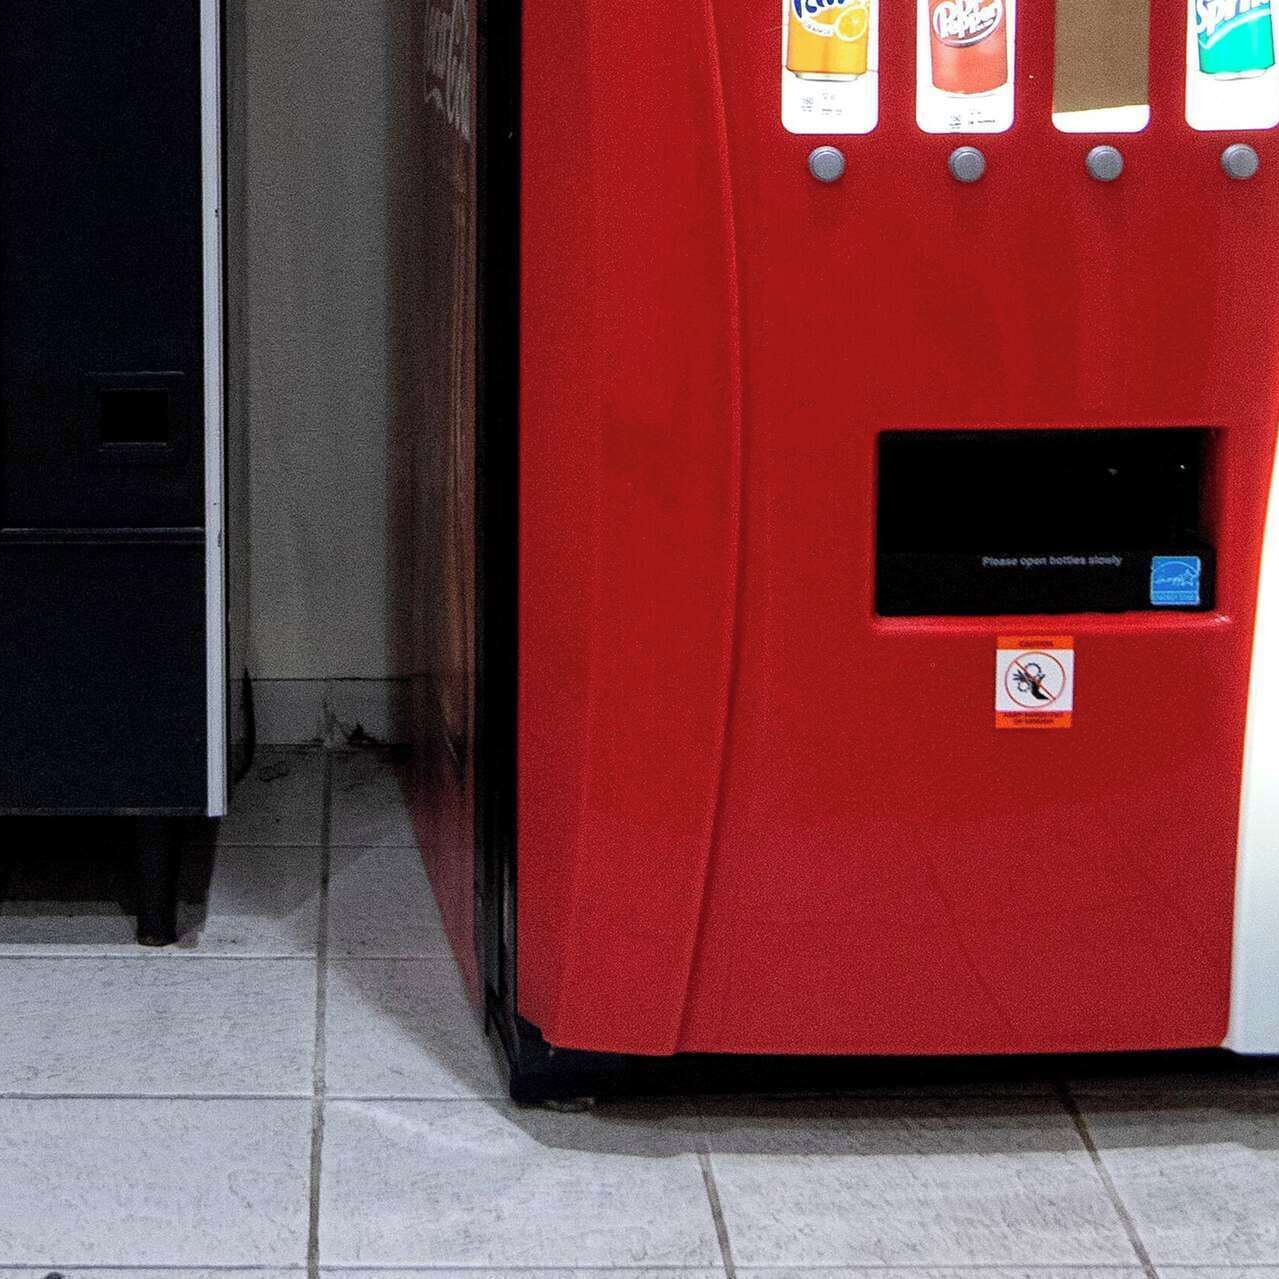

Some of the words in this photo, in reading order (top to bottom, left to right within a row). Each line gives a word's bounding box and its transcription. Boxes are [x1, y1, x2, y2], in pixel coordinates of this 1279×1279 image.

[982, 556, 1017, 566] Please
[1020, 557, 1047, 568] open
[1049, 555, 1086, 566] bottles
[1088, 555, 1121, 568] slowly
